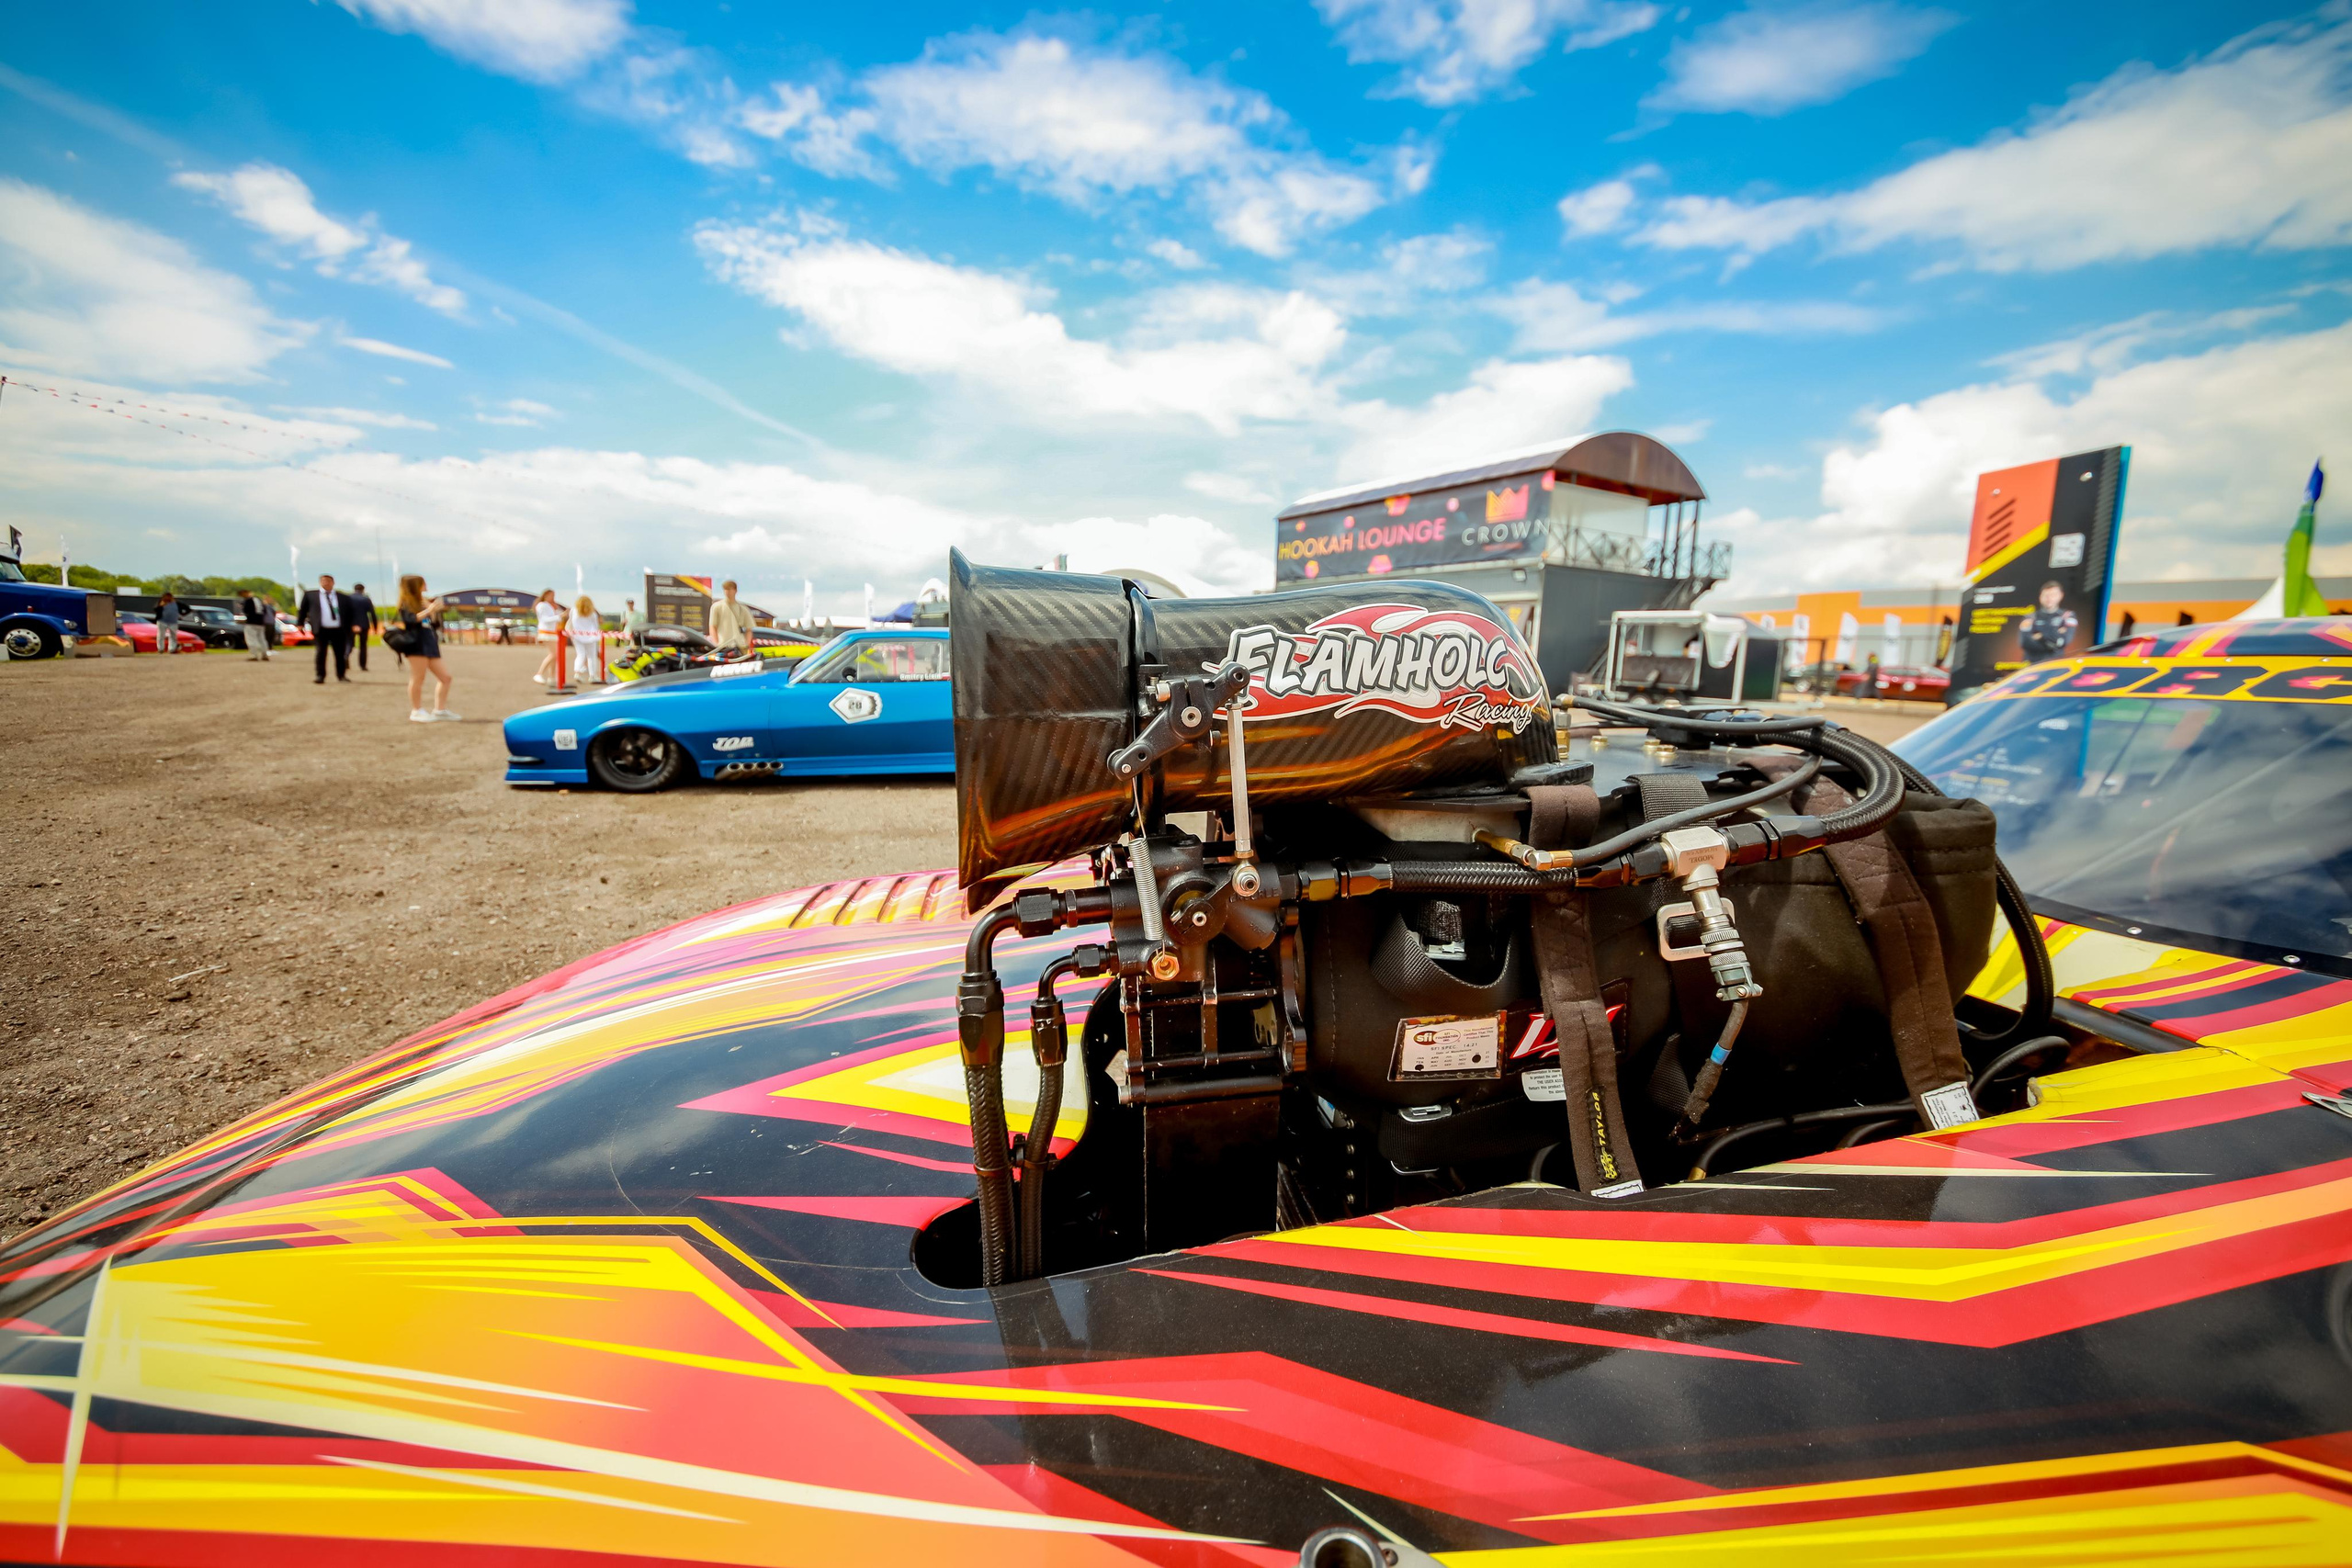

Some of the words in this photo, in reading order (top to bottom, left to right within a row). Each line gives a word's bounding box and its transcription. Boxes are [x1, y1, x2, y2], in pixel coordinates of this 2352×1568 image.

[1278, 532, 1353, 560] HOOKAH
[1357, 517, 1447, 551] LOUNGE
[1461, 518, 1551, 547] CROWN
[1232, 627, 1510, 696] FLAMHOLC
[1443, 692, 1533, 735] Racing
[1688, 854, 1714, 863] MODEL
[1416, 1032, 1432, 1042] sfi
[1592, 1092, 1606, 1145] TAYLOR
